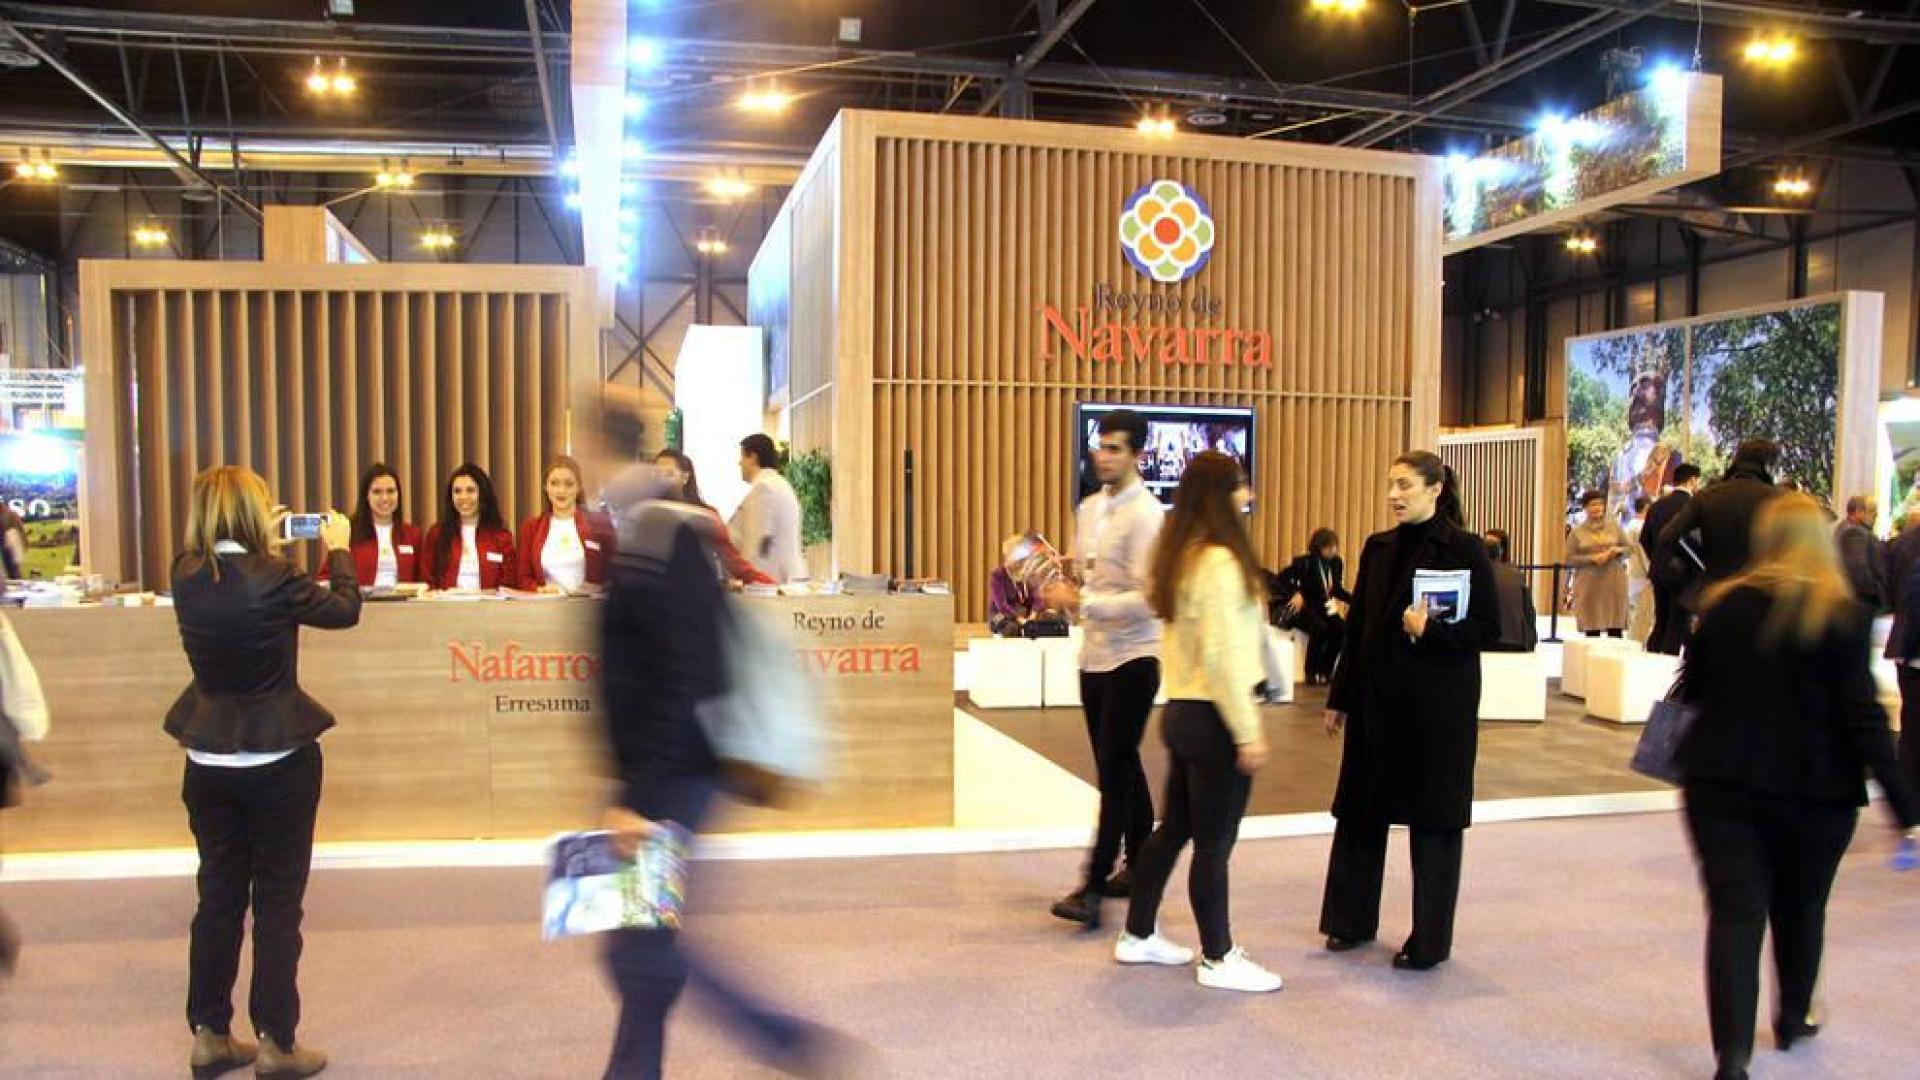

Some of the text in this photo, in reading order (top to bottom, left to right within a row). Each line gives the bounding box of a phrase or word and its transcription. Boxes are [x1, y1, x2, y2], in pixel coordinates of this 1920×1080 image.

[1095, 283, 1222, 319] Reyno de
[1037, 304, 1272, 368] Navarra
[793, 609, 885, 635] Reyno de
[449, 641, 601, 682] Nafarro
[496, 695, 591, 713] Erresuma
